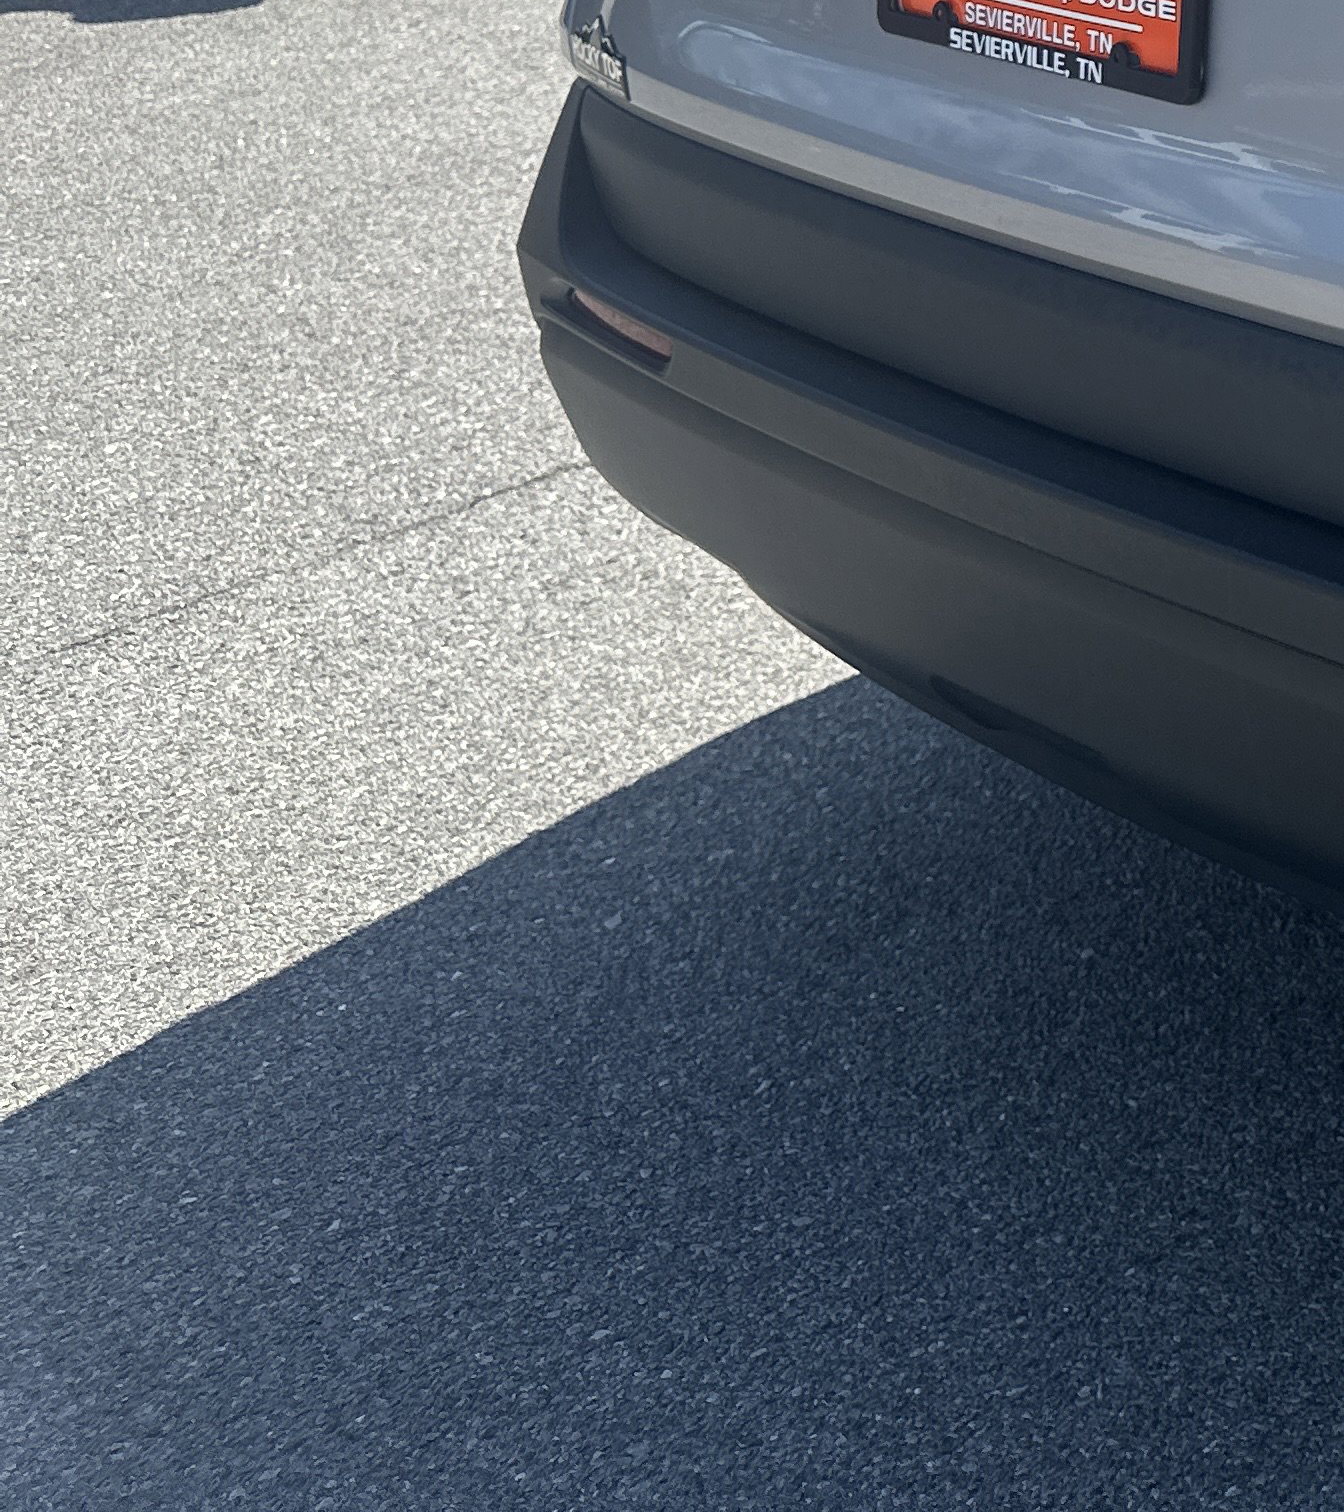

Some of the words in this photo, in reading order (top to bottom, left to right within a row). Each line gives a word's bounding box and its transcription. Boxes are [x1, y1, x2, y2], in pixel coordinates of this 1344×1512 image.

[949, 27, 1070, 79] SEVIERVILLE,
[1076, 56, 1103, 84] TN
[964, 1, 1081, 52] SEVIERVILLE,
[1087, 29, 1113, 55] TN
